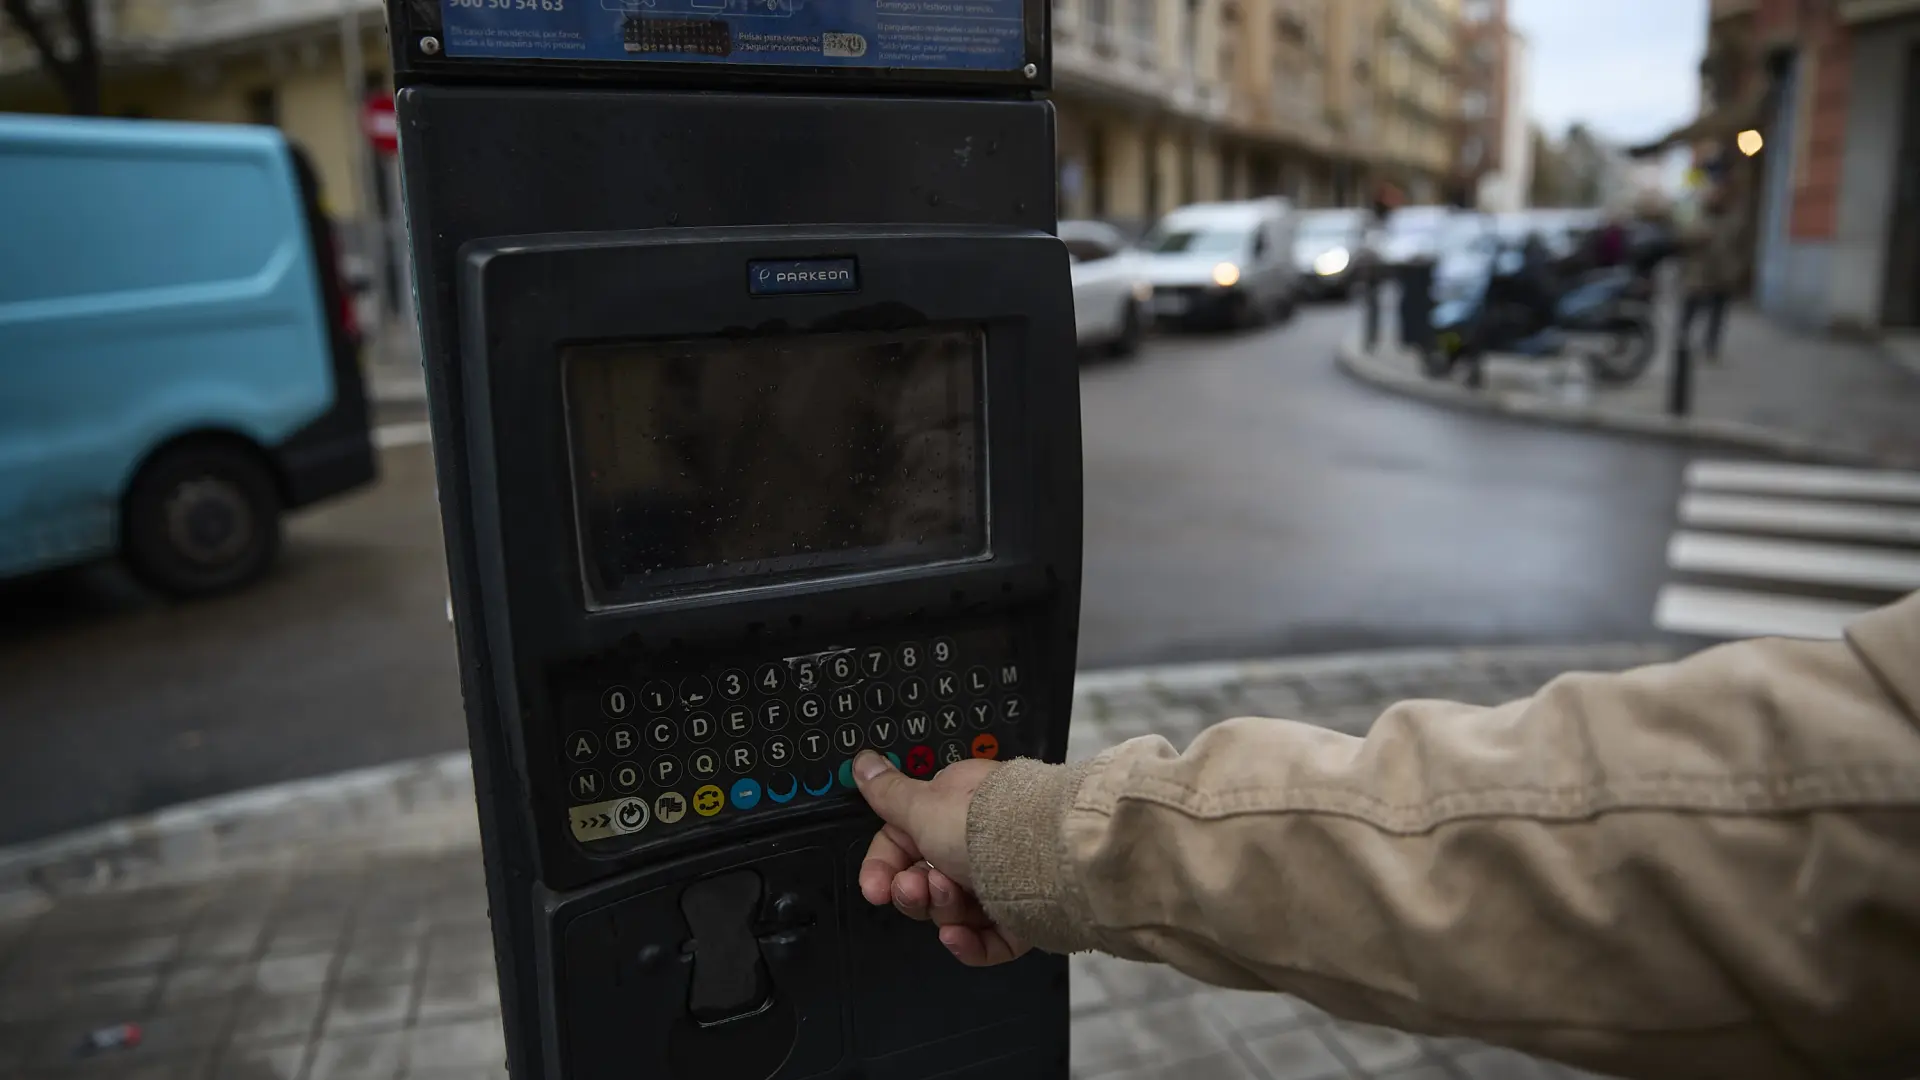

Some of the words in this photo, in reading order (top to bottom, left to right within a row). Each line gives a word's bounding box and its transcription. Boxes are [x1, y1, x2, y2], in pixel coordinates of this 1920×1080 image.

[542, 0, 565, 11] 63
[776, 270, 849, 283] PARKEON
[575, 738, 592, 757] A
[615, 731, 631, 750] B
[655, 724, 670, 743] C
[693, 718, 708, 737] D
[731, 712, 745, 730] E
[768, 706, 780, 724] F
[803, 700, 818, 718] G
[838, 694, 852, 713] H
[876, 689, 883, 706] I
[908, 683, 918, 700] J
[940, 677, 953, 695] K
[973, 673, 984, 689] L
[1003, 666, 1017, 684] M
[611, 692, 625, 713] 0
[727, 675, 741, 695] 3
[764, 669, 778, 688] 4
[801, 663, 814, 684] 5
[835, 658, 849, 678] 6
[869, 652, 881, 673] 7
[903, 647, 916, 667] 8
[936, 642, 949, 662] 9
[579, 775, 595, 794] N
[659, 762, 673, 780] P
[696, 755, 714, 773] Q
[734, 749, 750, 767] R
[771, 742, 785, 760] S
[807, 735, 820, 753] T
[842, 729, 856, 747] U
[876, 723, 890, 741] V
[907, 716, 926, 735] W
[943, 711, 957, 729] X
[975, 705, 988, 722] Y
[1006, 700, 1019, 718] Z
